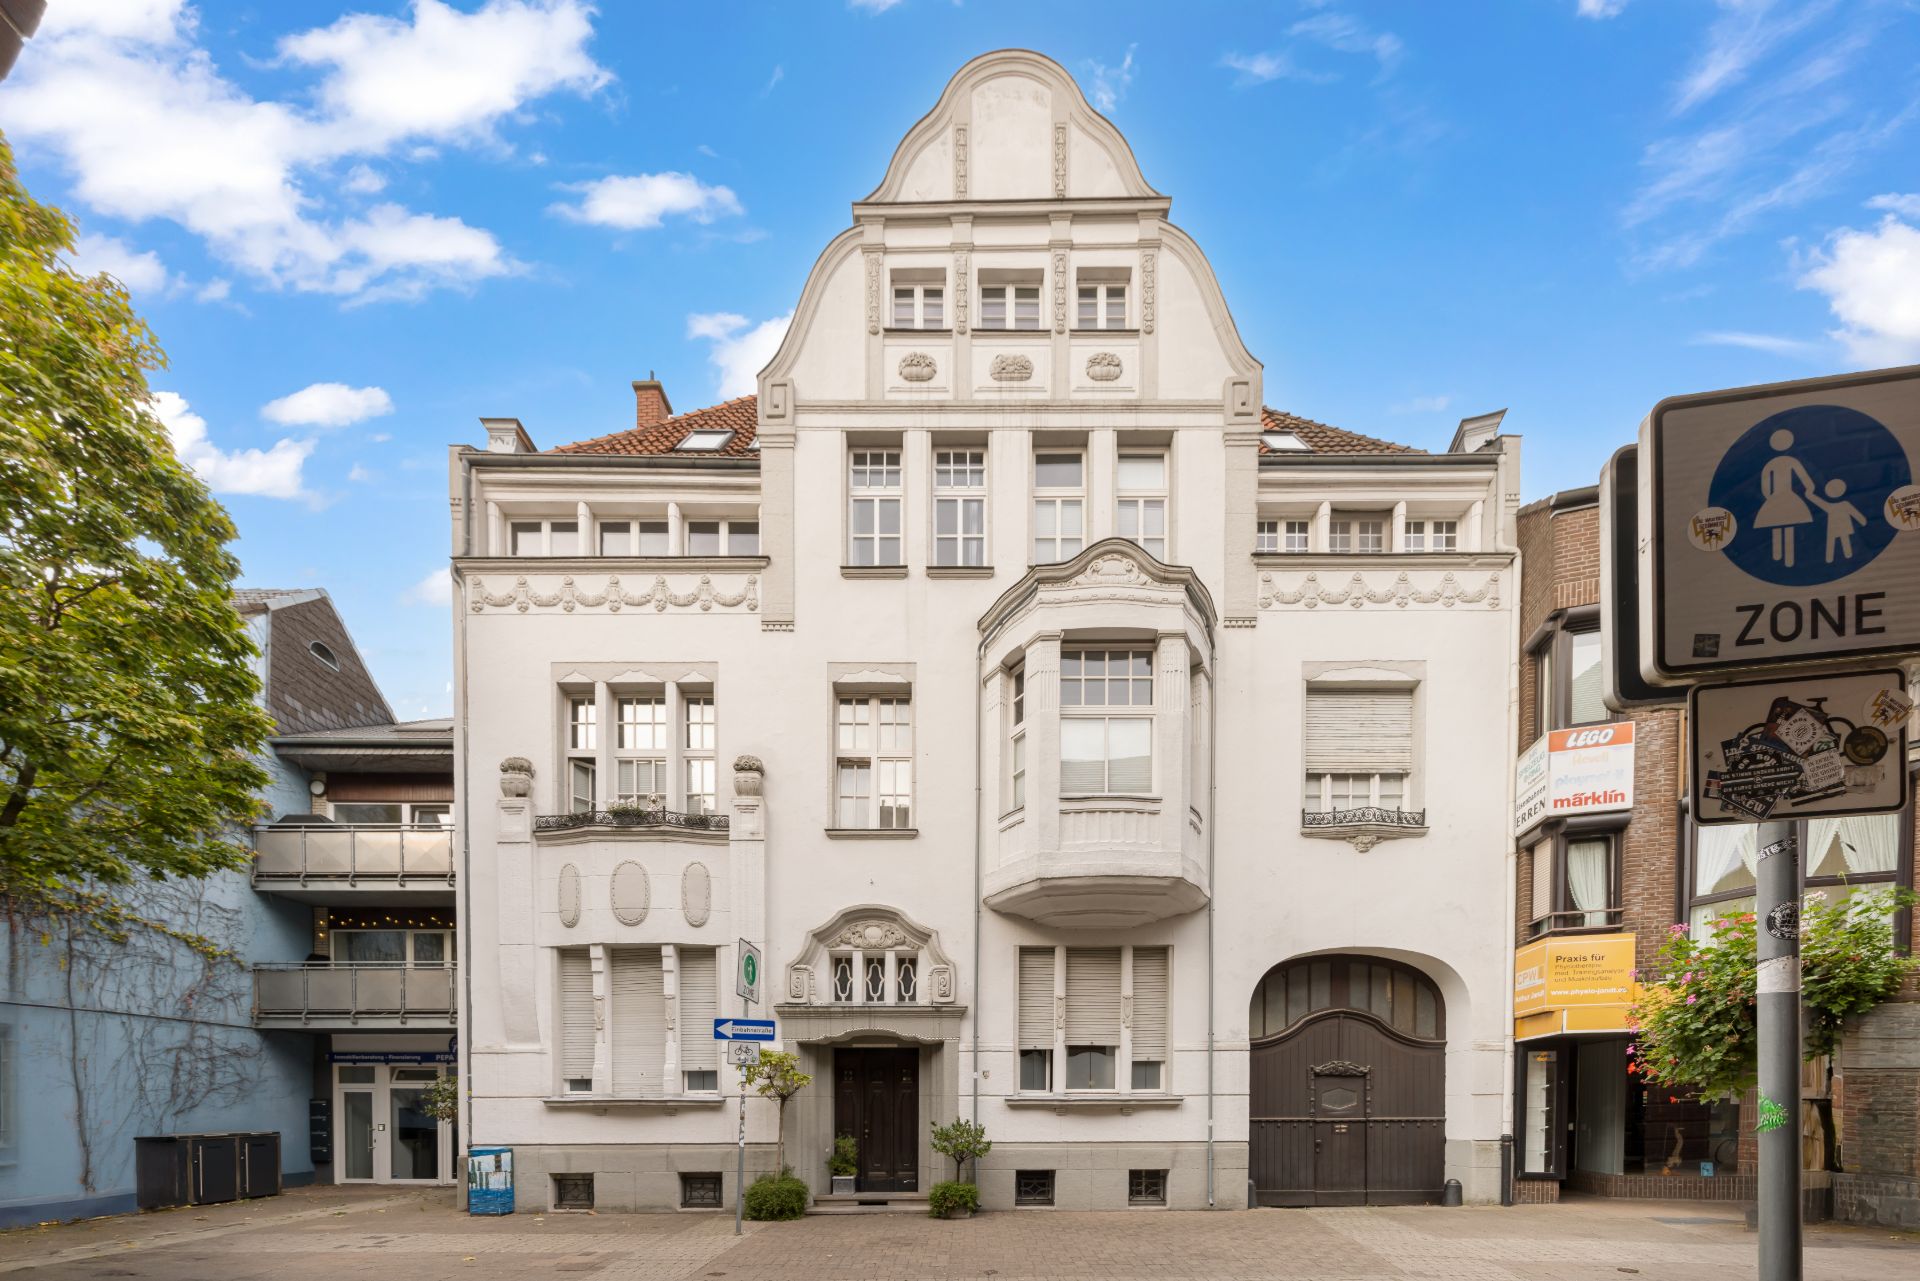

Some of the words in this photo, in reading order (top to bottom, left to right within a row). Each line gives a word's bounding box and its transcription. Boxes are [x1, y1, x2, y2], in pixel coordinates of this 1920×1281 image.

[1735, 591, 1886, 647] ZONE
[1567, 729, 1614, 747] LEGO
[1553, 790, 1625, 809] märklin
[1555, 955, 1588, 963] Praxis
[1591, 953, 1606, 961] für
